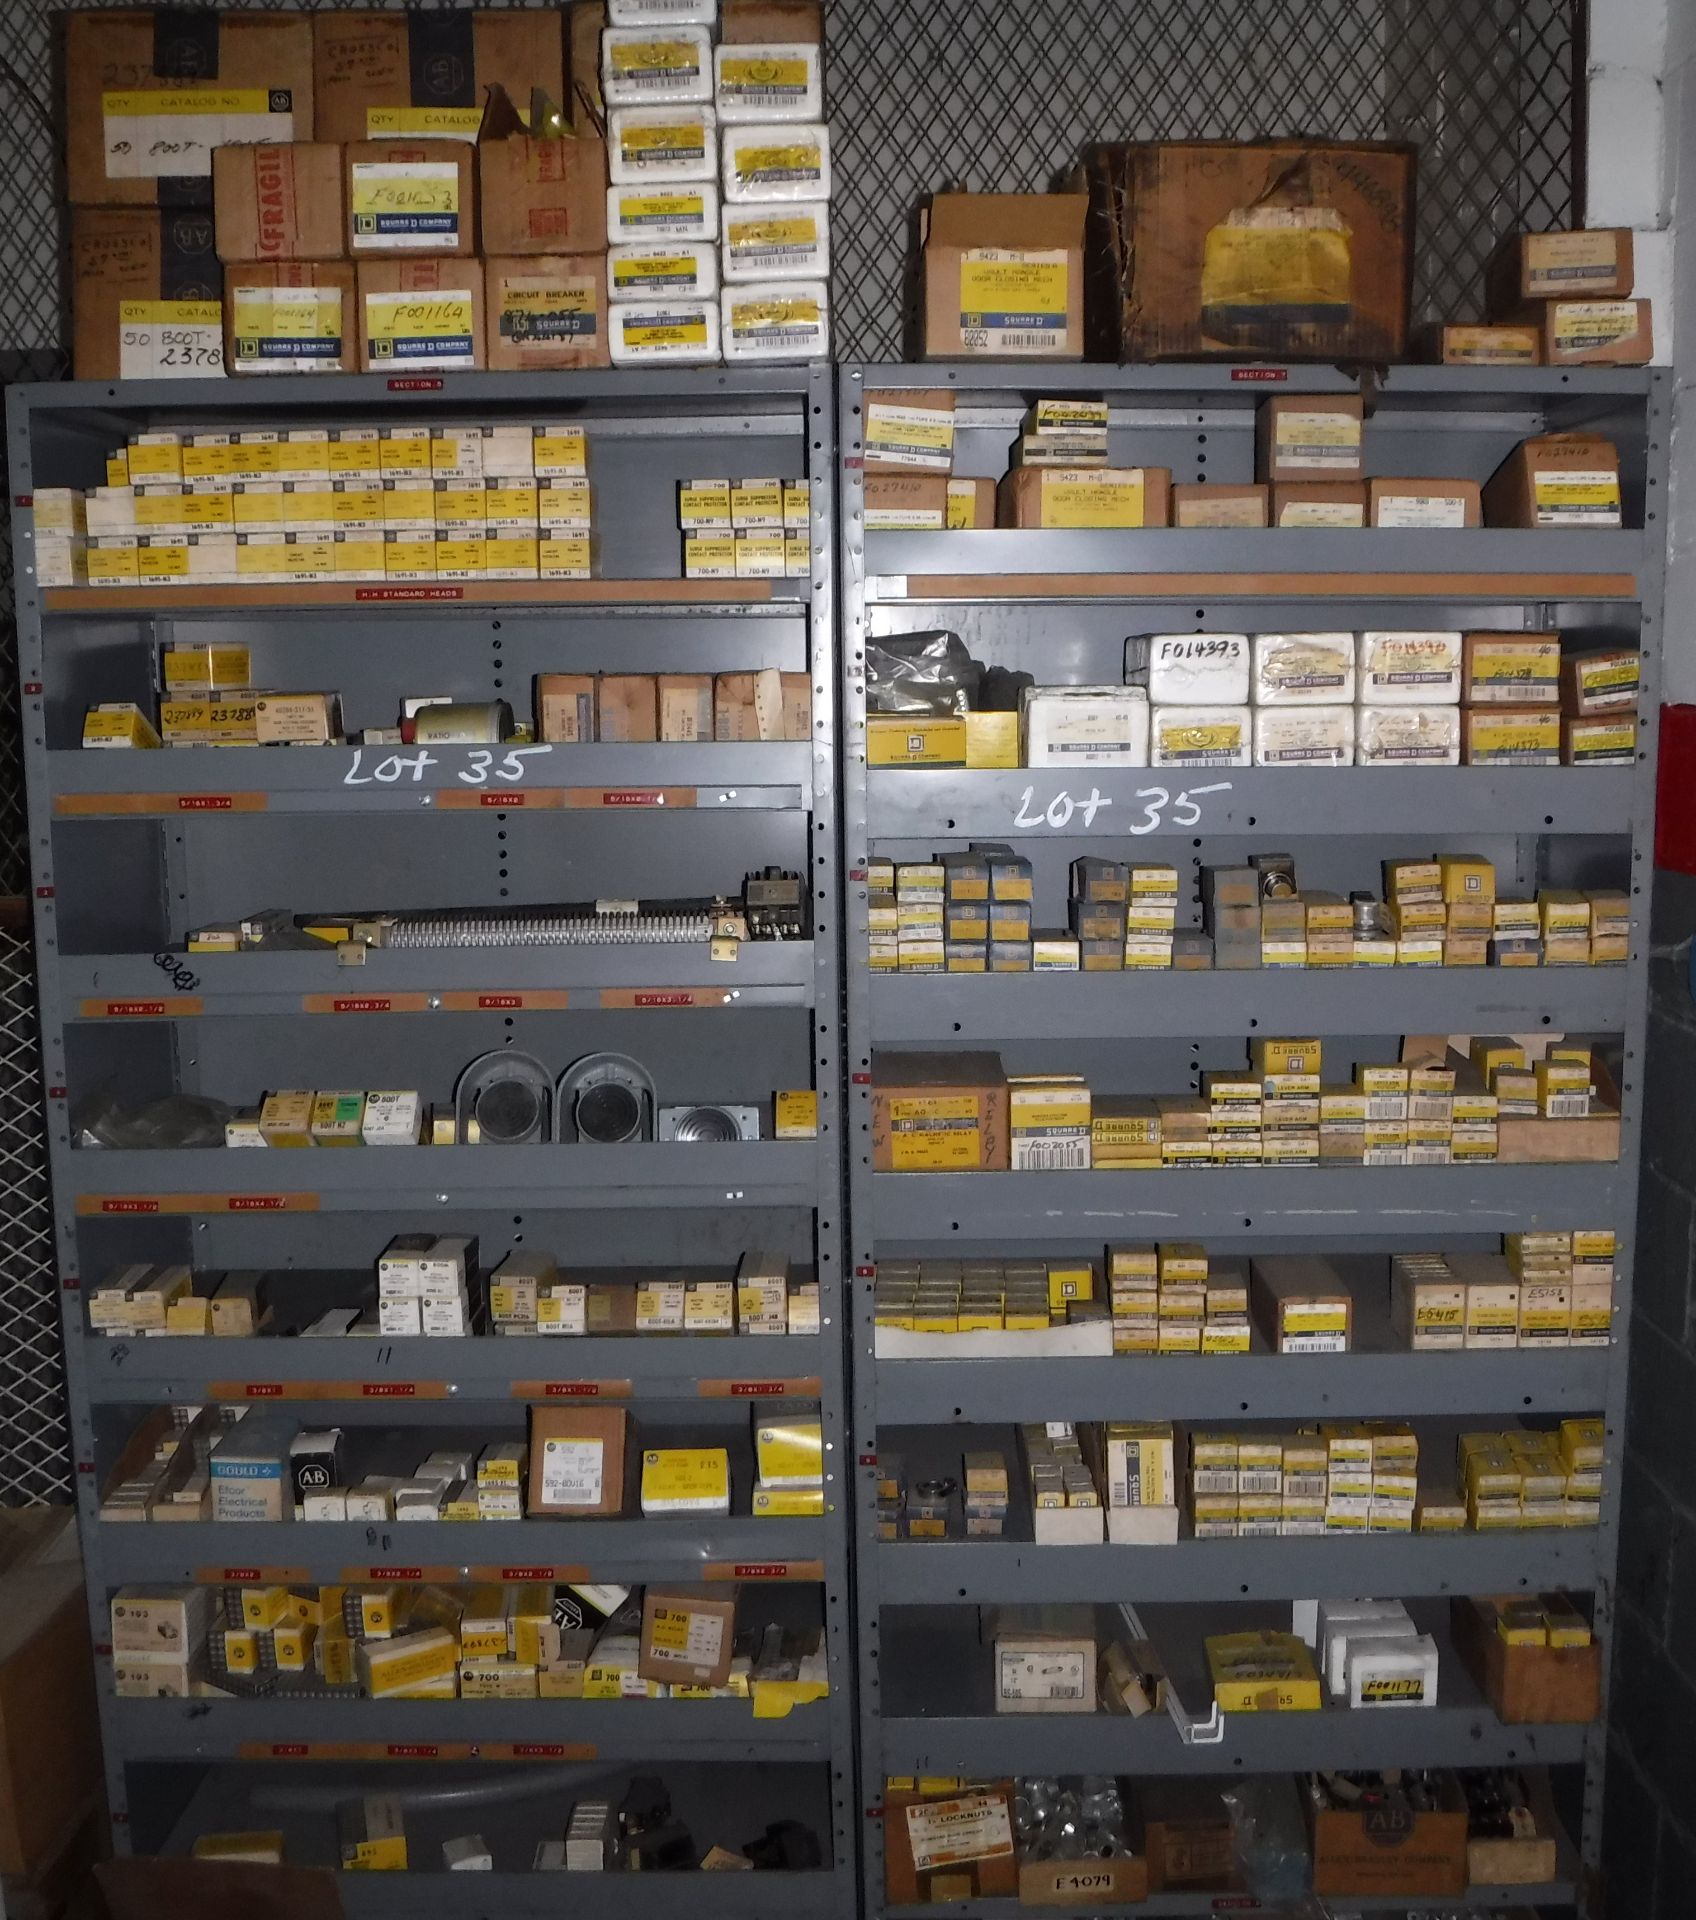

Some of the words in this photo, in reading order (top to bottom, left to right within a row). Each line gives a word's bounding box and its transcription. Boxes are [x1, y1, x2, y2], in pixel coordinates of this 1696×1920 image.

[107, 99, 129, 108] QTY
[160, 97, 217, 106] CATALOG
[371, 115, 393, 124] QTY
[424, 115, 480, 124] CATALOG
[381, 219, 409, 227] SQUARE
[419, 219, 451, 227] COMPANY
[507, 291, 539, 299] CIRCUIT
[124, 308, 146, 316] QTY
[394, 303, 463, 322] F001164
[123, 332, 151, 346] 50
[262, 342, 290, 350] SQUARE
[302, 342, 335, 350] COMPANY
[397, 342, 426, 350] SQUARE
[436, 341, 469, 349] COMPANY
[395, 381, 432, 389] SECTION
[1160, 640, 1240, 660] F014393
[458, 745, 553, 784] 35
[1130, 782, 1233, 835] 35
[1046, 1128, 1078, 1136] SQUARE
[218, 1496, 268, 1508] Electrical
[218, 1507, 267, 1519] Products
[671, 1614, 688, 1623] 700
[653, 1648, 670, 1658] 700
[479, 1673, 500, 1682] 700
[606, 1673, 620, 1682] 700
[940, 1810, 994, 1823] LOCKNUTS
